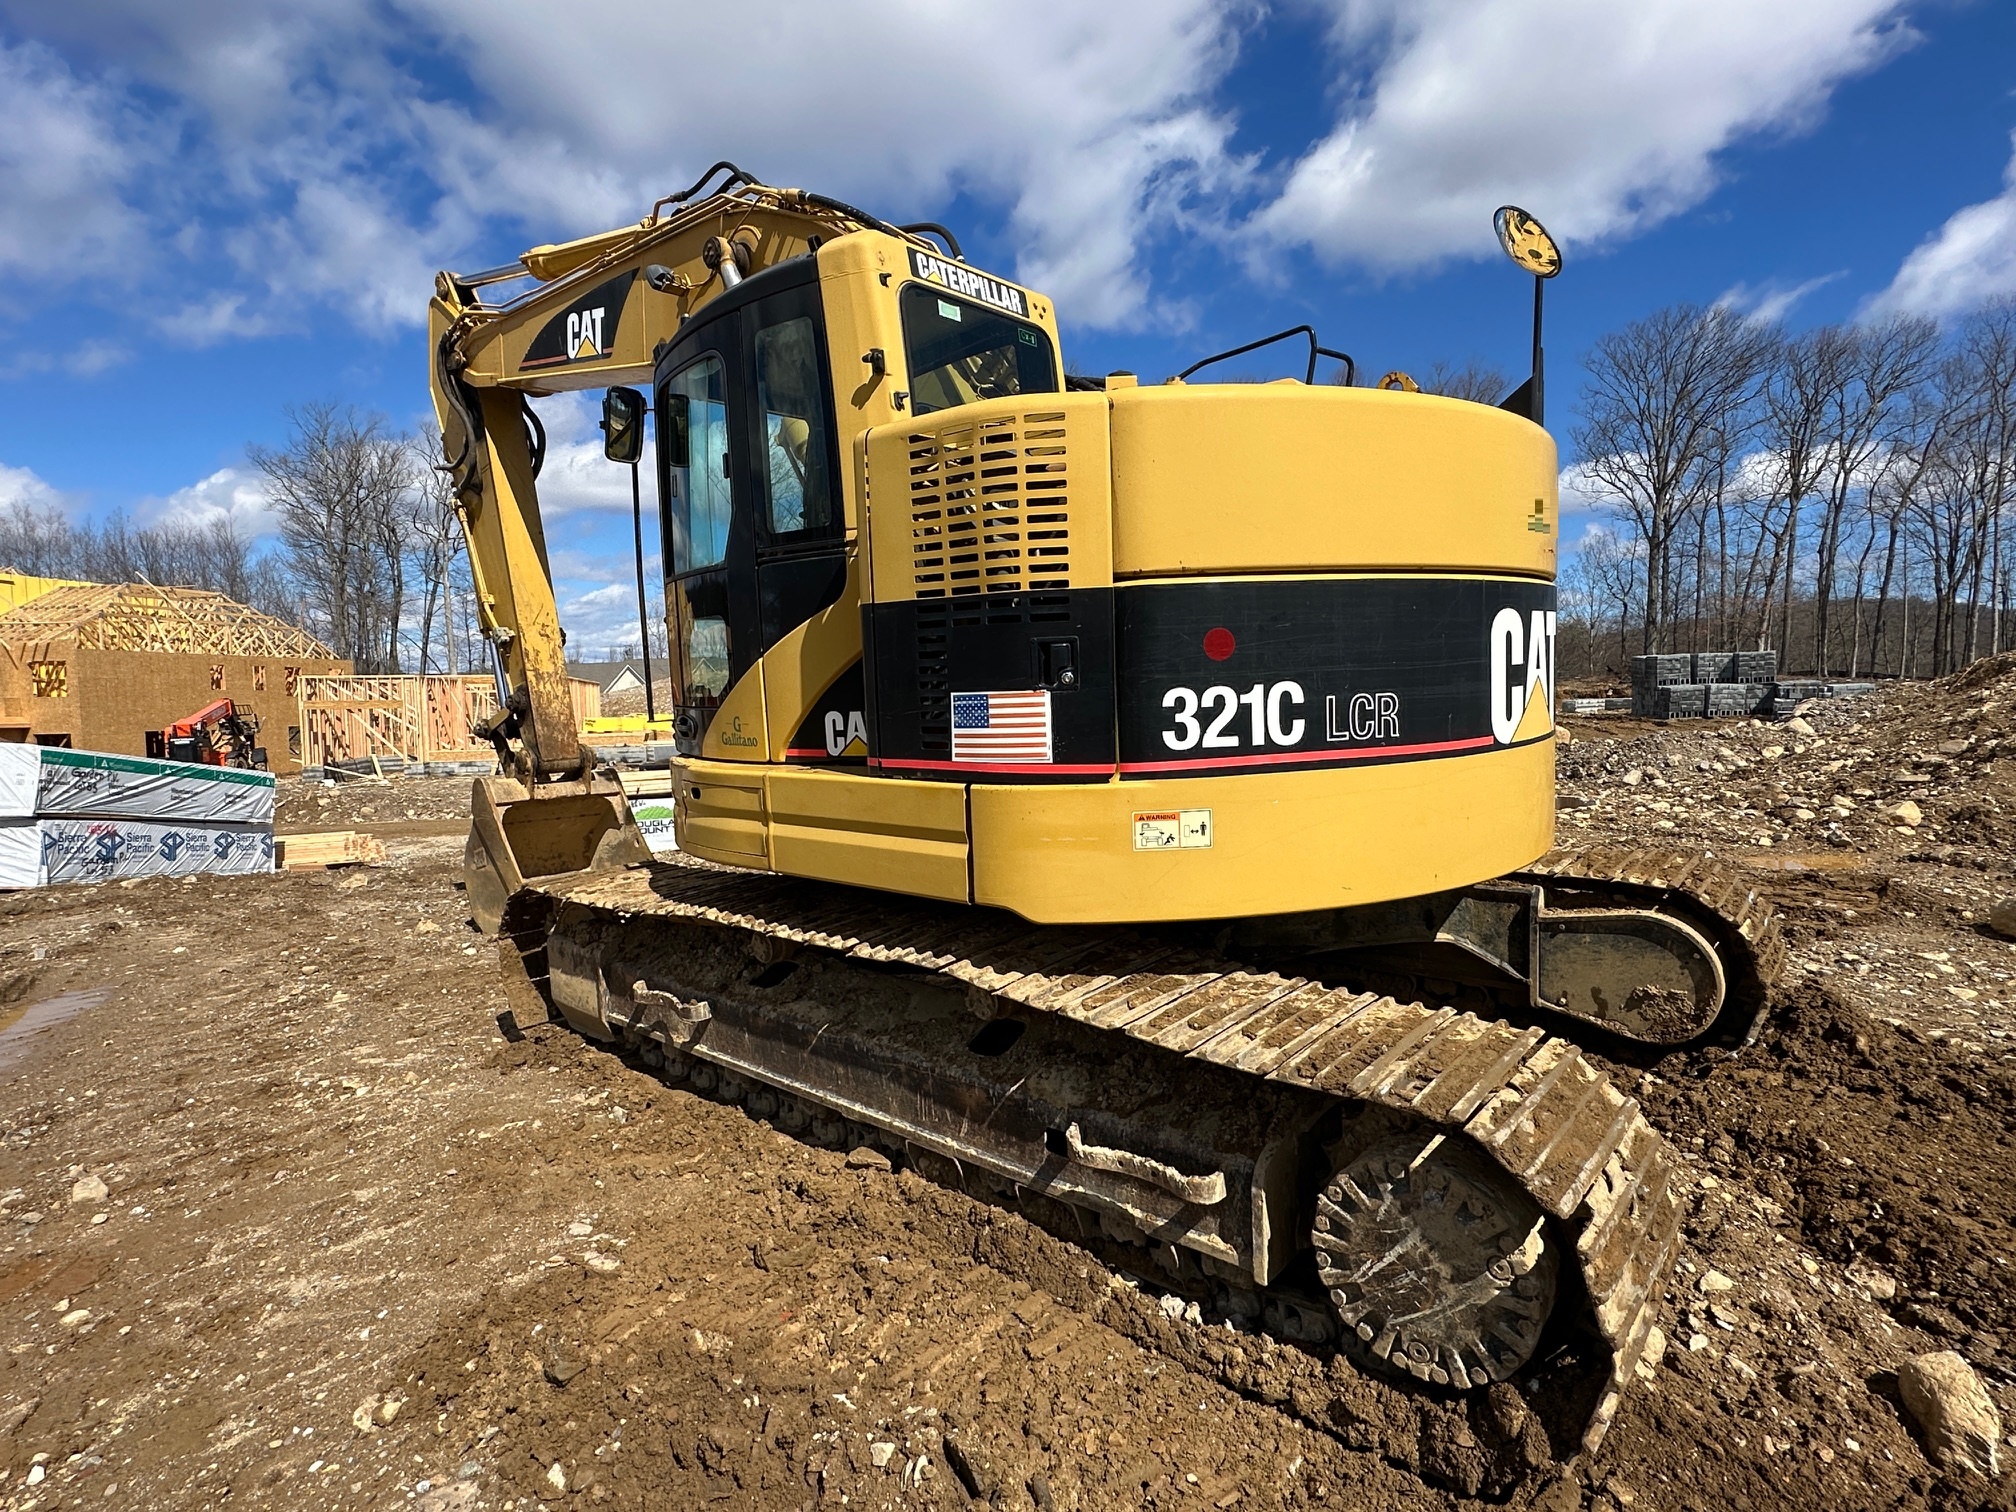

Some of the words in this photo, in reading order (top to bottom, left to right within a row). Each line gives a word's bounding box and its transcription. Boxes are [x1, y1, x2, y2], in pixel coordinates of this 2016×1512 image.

[915, 251, 1023, 315] CATERPILLAR
[566, 306, 605, 359] CAT
[1161, 680, 1306, 751] 321C
[1325, 692, 1400, 742] LCR
[732, 716, 742, 733] G
[824, 710, 868, 757] CA
[721, 732, 758, 748] Gallitano
[636, 818, 675, 828] OUGLA
[58, 832, 87, 843] Sierra
[126, 832, 152, 843] Sierra
[185, 833, 208, 843] Sierra
[236, 833, 256, 842] Sierra
[126, 843, 155, 854] Pacific
[185, 842, 210, 852] Pacific
